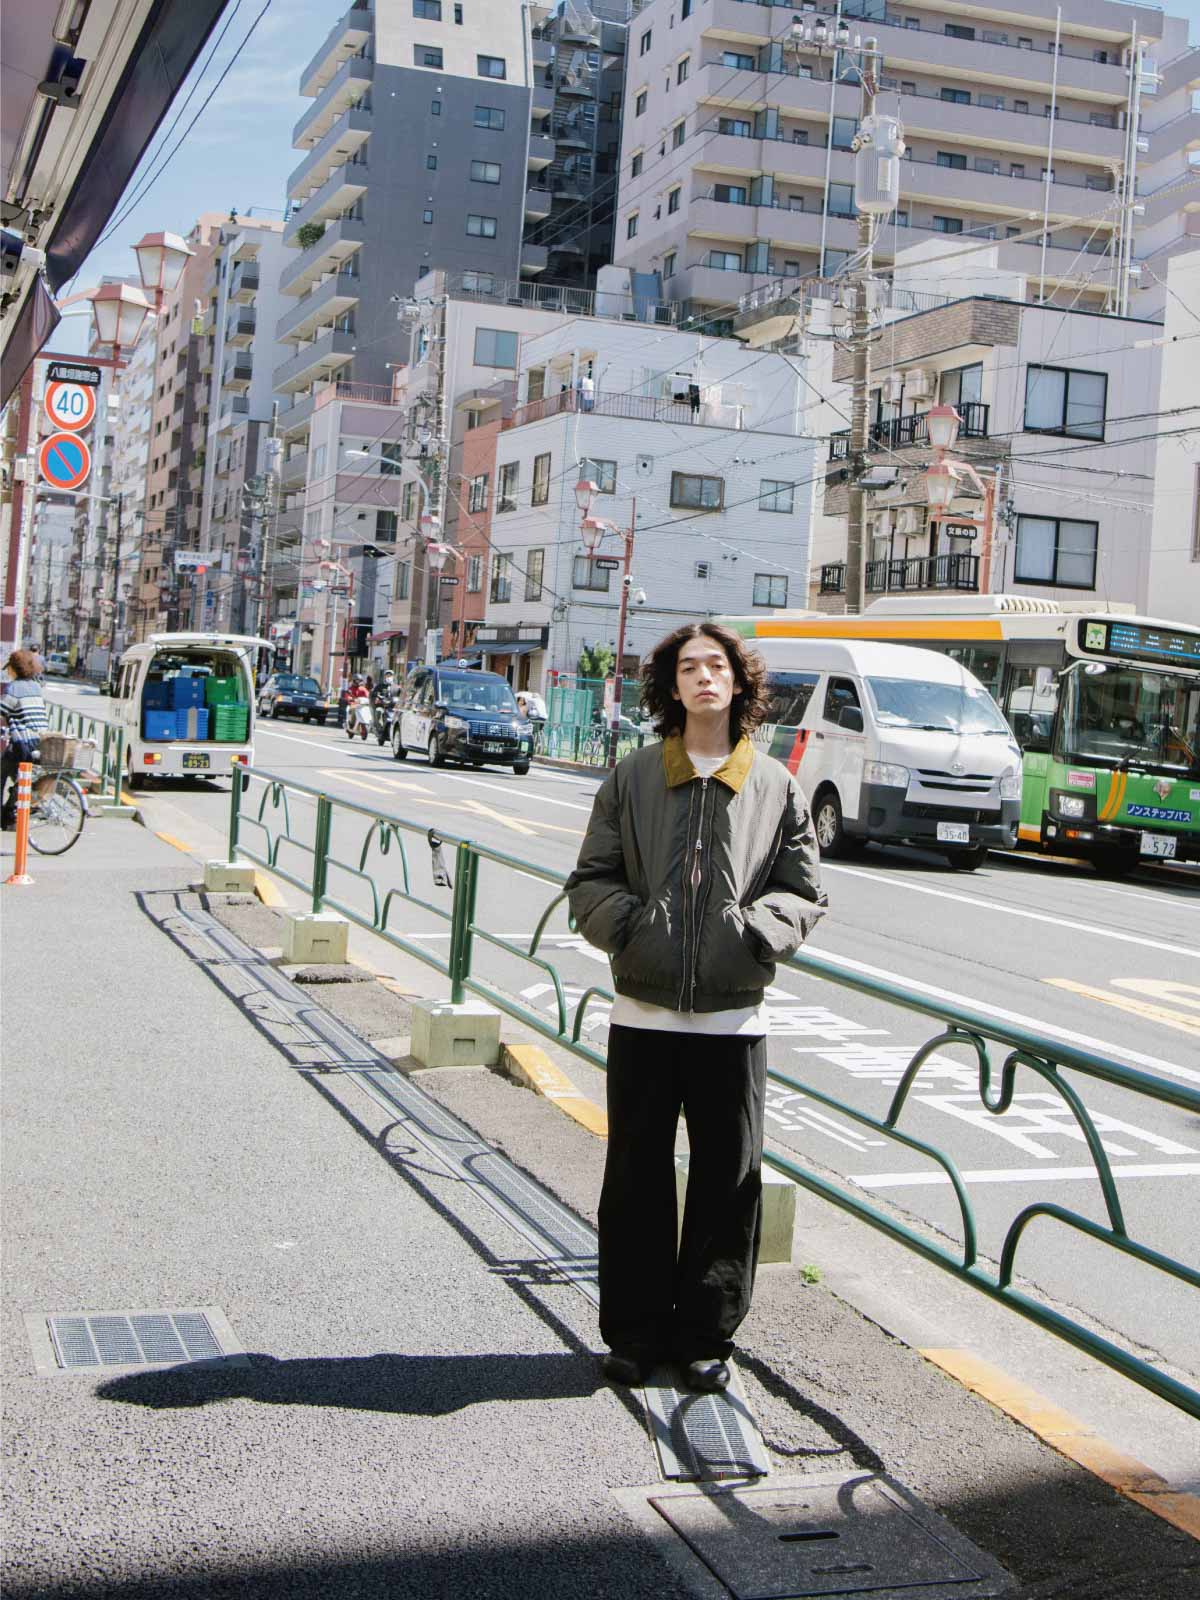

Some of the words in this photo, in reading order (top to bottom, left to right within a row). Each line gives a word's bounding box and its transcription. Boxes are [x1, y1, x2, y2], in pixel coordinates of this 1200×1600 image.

[56, 390, 84, 416] 40
[1127, 805, 1190, 822] ノンステップバス
